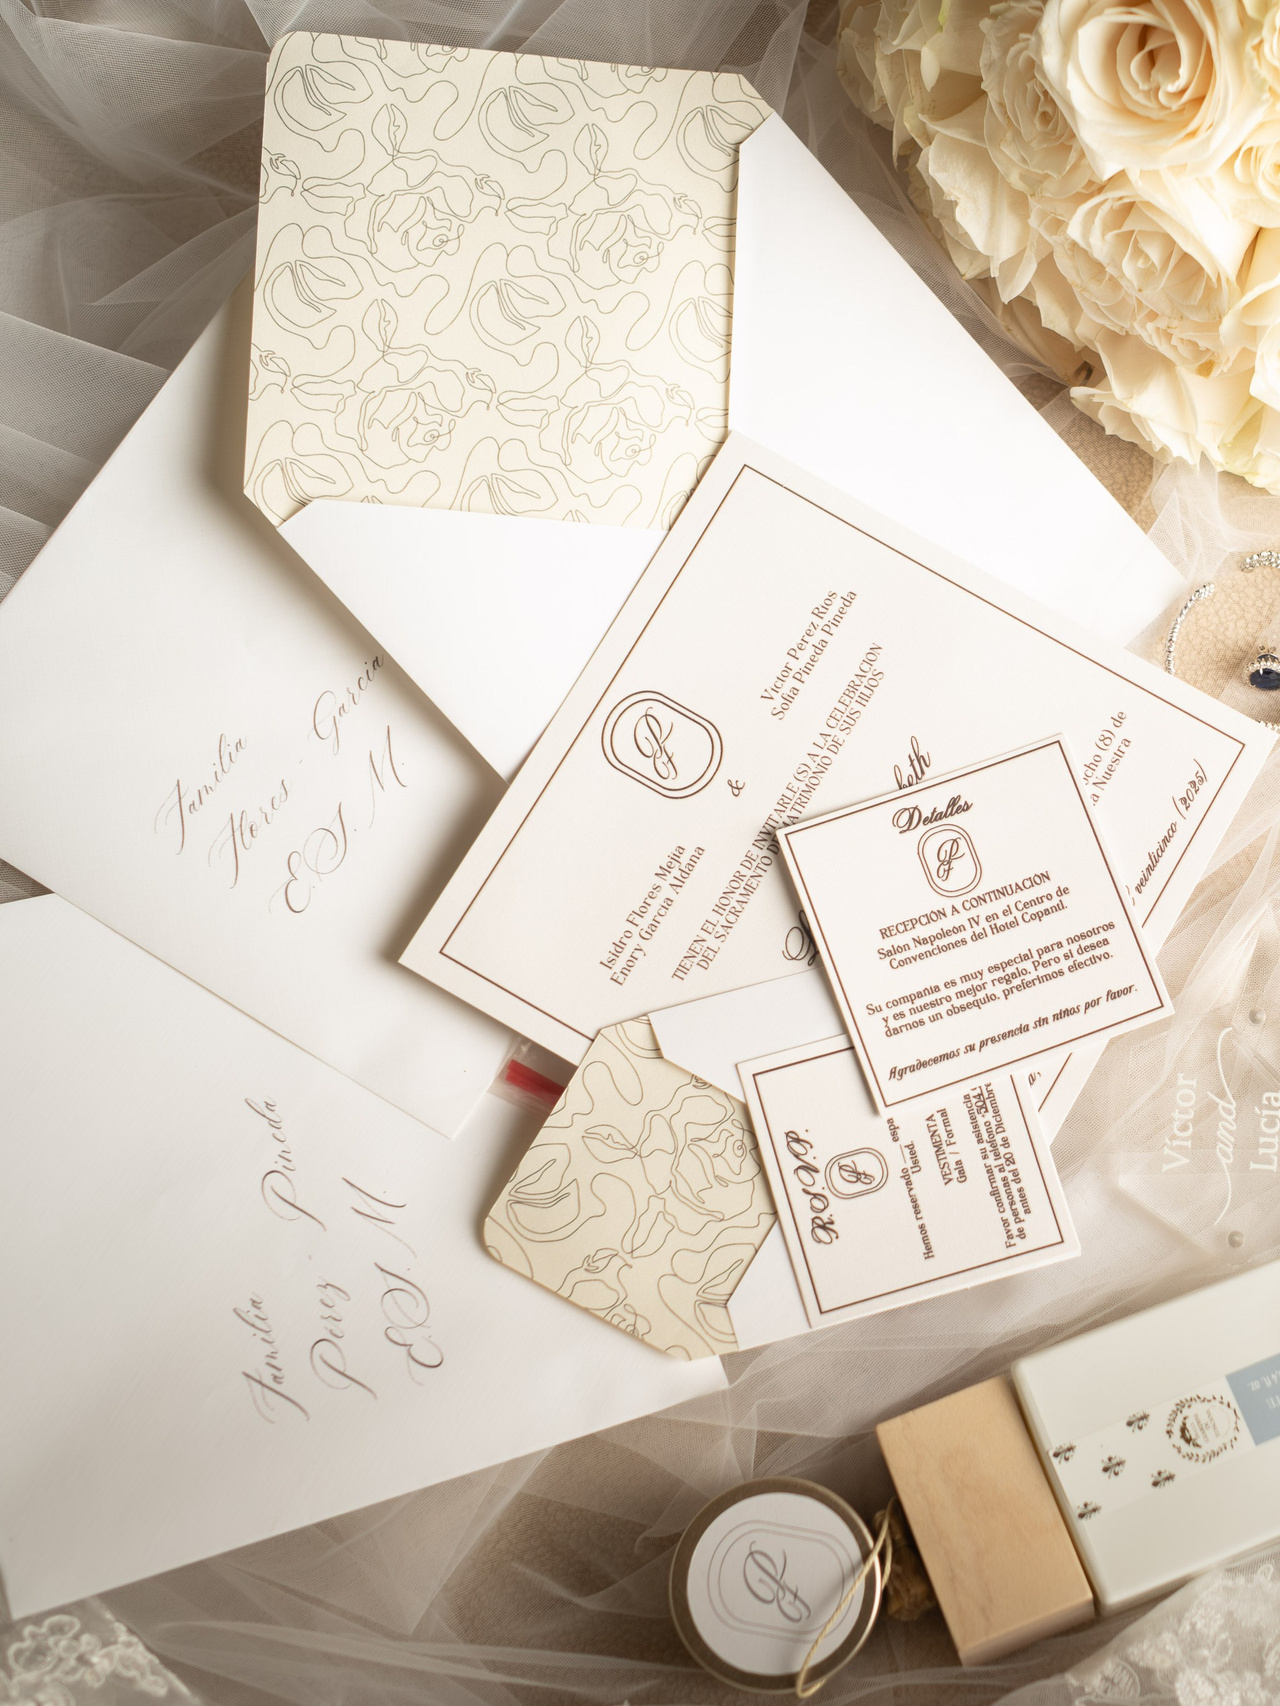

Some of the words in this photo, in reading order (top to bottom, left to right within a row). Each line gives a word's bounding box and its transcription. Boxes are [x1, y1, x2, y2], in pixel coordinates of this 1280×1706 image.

[792, 638, 828, 683] Pineda
[821, 591, 856, 636] Pineda
[806, 752, 819, 763] A
[812, 732, 831, 749] LA
[1095, 728, 1117, 754] (8)
[1110, 710, 1127, 730] de
[792, 762, 811, 782] (S)
[1092, 737, 1132, 790] Nuestra
[154, 732, 248, 856] Familia
[695, 945, 720, 970] DEL
[716, 856, 773, 942] SACRAMENTO
[826, 734, 845, 754] DE
[838, 707, 861, 735] SUS
[854, 668, 884, 707] HIJOS
[751, 782, 799, 850] INVITARLE
[892, 794, 973, 834] Detalles
[208, 779, 293, 890] Flores
[1134, 821, 1178, 895] veinticinco
[1172, 758, 1208, 820] (2025)
[739, 849, 758, 870] DE
[609, 943, 644, 985] Enory
[668, 846, 705, 894] Aldana
[711, 870, 746, 916] HONOR
[879, 907, 947, 939] RECEPCIÓN
[950, 904, 960, 916] A
[961, 870, 1050, 911] CONTINUACIÓN
[599, 929, 633, 969] Isidro
[625, 883, 661, 927] Flores
[700, 919, 719, 935] EL
[876, 943, 911, 959] Salón
[911, 924, 966, 948] Napoleón
[966, 914, 980, 928] IV
[984, 912, 999, 925] en
[1001, 903, 1012, 916] el
[1014, 892, 1053, 913] Centro
[1055, 885, 1069, 900] de
[889, 938, 967, 969] Convenciones
[970, 926, 988, 942] del
[988, 915, 1019, 935] Hotel
[1020, 898, 1067, 923] Copantl.
[671, 934, 706, 980] TIENEN
[865, 1003, 883, 1015] Su
[943, 978, 957, 989] es
[959, 968, 983, 983] muy
[987, 948, 1034, 973] especial
[1035, 940, 1063, 958] para
[1065, 921, 1115, 945] nosotros
[881, 1015, 888, 1026] y
[892, 1010, 906, 1021] es
[908, 994, 952, 1015] nuestro
[954, 981, 988, 999] mejor
[1031, 955, 1060, 971] Pero
[1062, 948, 1076, 961] si
[1076, 937, 1109, 955] desea
[884, 1016, 925, 1037] darnos
[927, 1011, 943, 1023] un
[1001, 968, 1064, 999] preferimos
[1067, 951, 1113, 973] efectivo.
[888, 1048, 960, 1081] Agradecemos
[962, 1042, 976, 1054] su
[978, 1023, 1029, 1052] presencia
[1032, 1016, 1049, 1029] sin
[1083, 996, 1102, 1014] por
[1105, 984, 1137, 1002] favor.
[935, 1107, 956, 1146] Formal
[962, 1093, 985, 1144] asistencia
[997, 1135, 1010, 1149] de
[1161, 1073, 1197, 1173] Víctor
[245, 1095, 328, 1232] Pineda
[903, 1140, 921, 1174] Usted.
[925, 1113, 951, 1185] VESTIMENTA
[953, 1158, 967, 1183] Gala
[979, 1146, 990, 1160] su
[997, 1162, 1007, 1174] al
[1001, 1151, 1016, 1166] 20
[900, 1168, 923, 1221] reservado
[983, 1162, 1005, 1213] confirmar
[1000, 1176, 1024, 1223] personas
[1007, 1167, 1021, 1184] del
[1017, 1187, 1031, 1214] antes
[917, 1223, 935, 1259] Hemos
[1000, 1216, 1016, 1248] Favor
[1013, 1226, 1026, 1239] de
[233, 1291, 310, 1424] Familia
